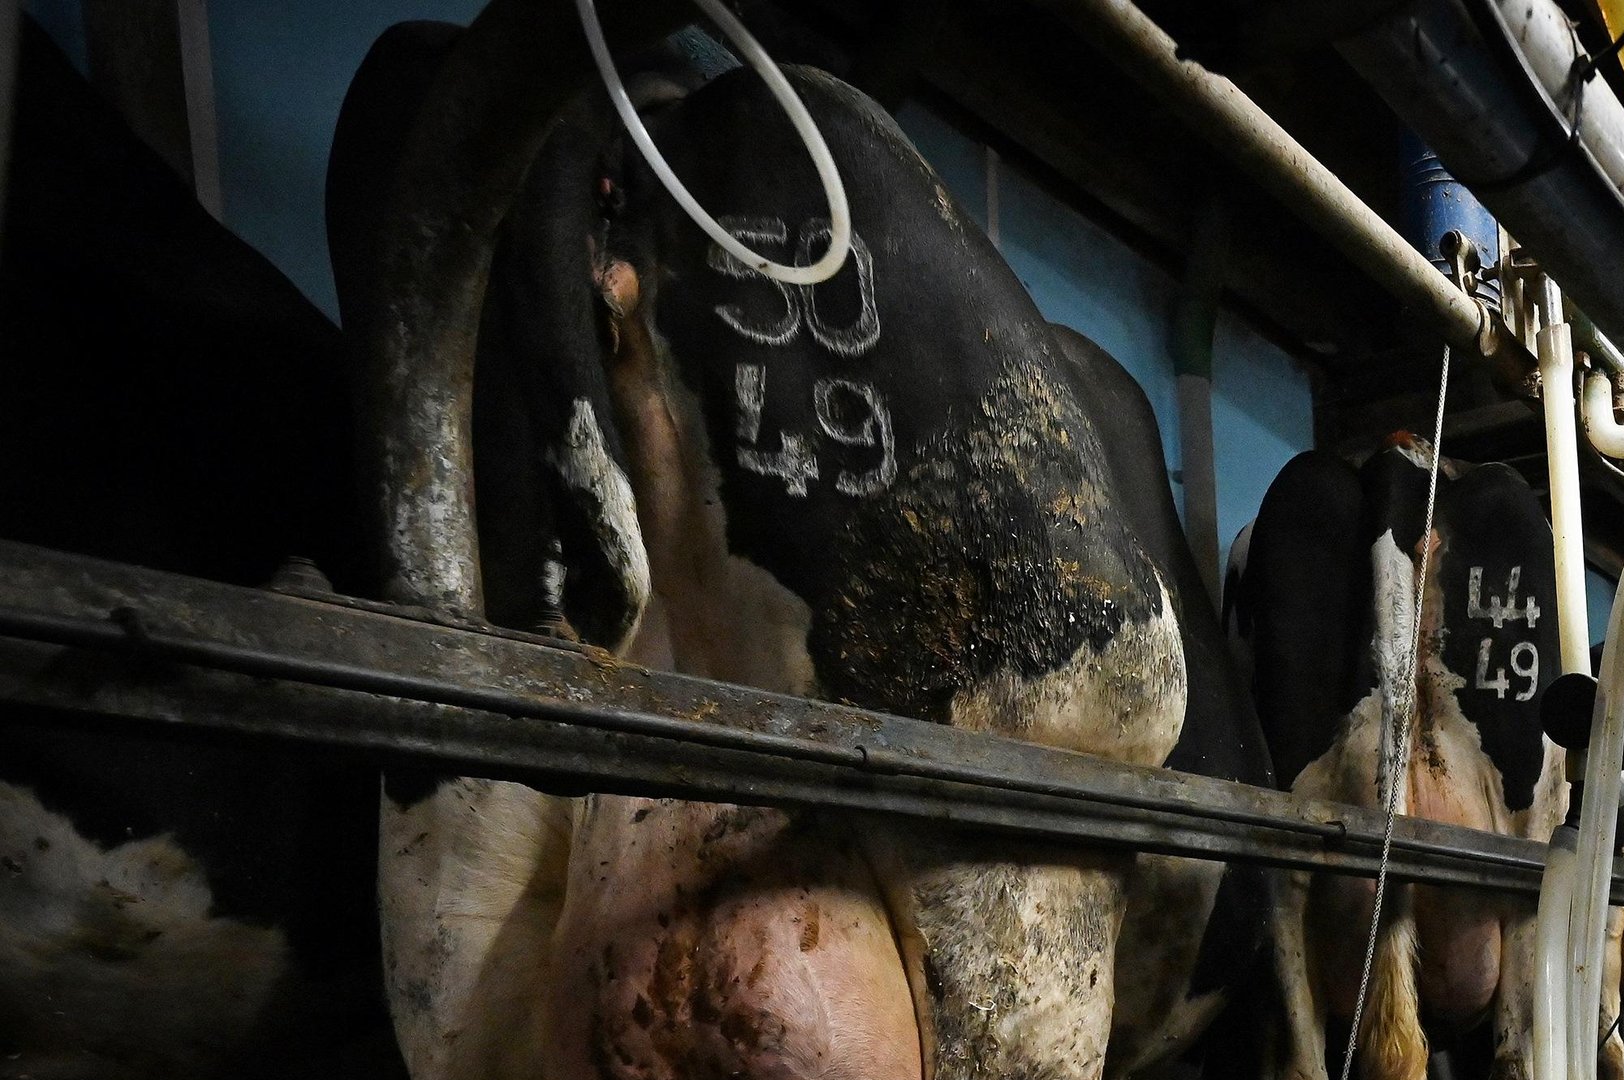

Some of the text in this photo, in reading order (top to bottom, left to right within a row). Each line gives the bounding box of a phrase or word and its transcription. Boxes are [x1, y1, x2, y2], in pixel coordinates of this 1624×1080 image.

[706, 215, 881, 357] 50
[735, 362, 898, 497] 49
[1467, 565, 1541, 629] 44
[1475, 637, 1539, 702] 49
